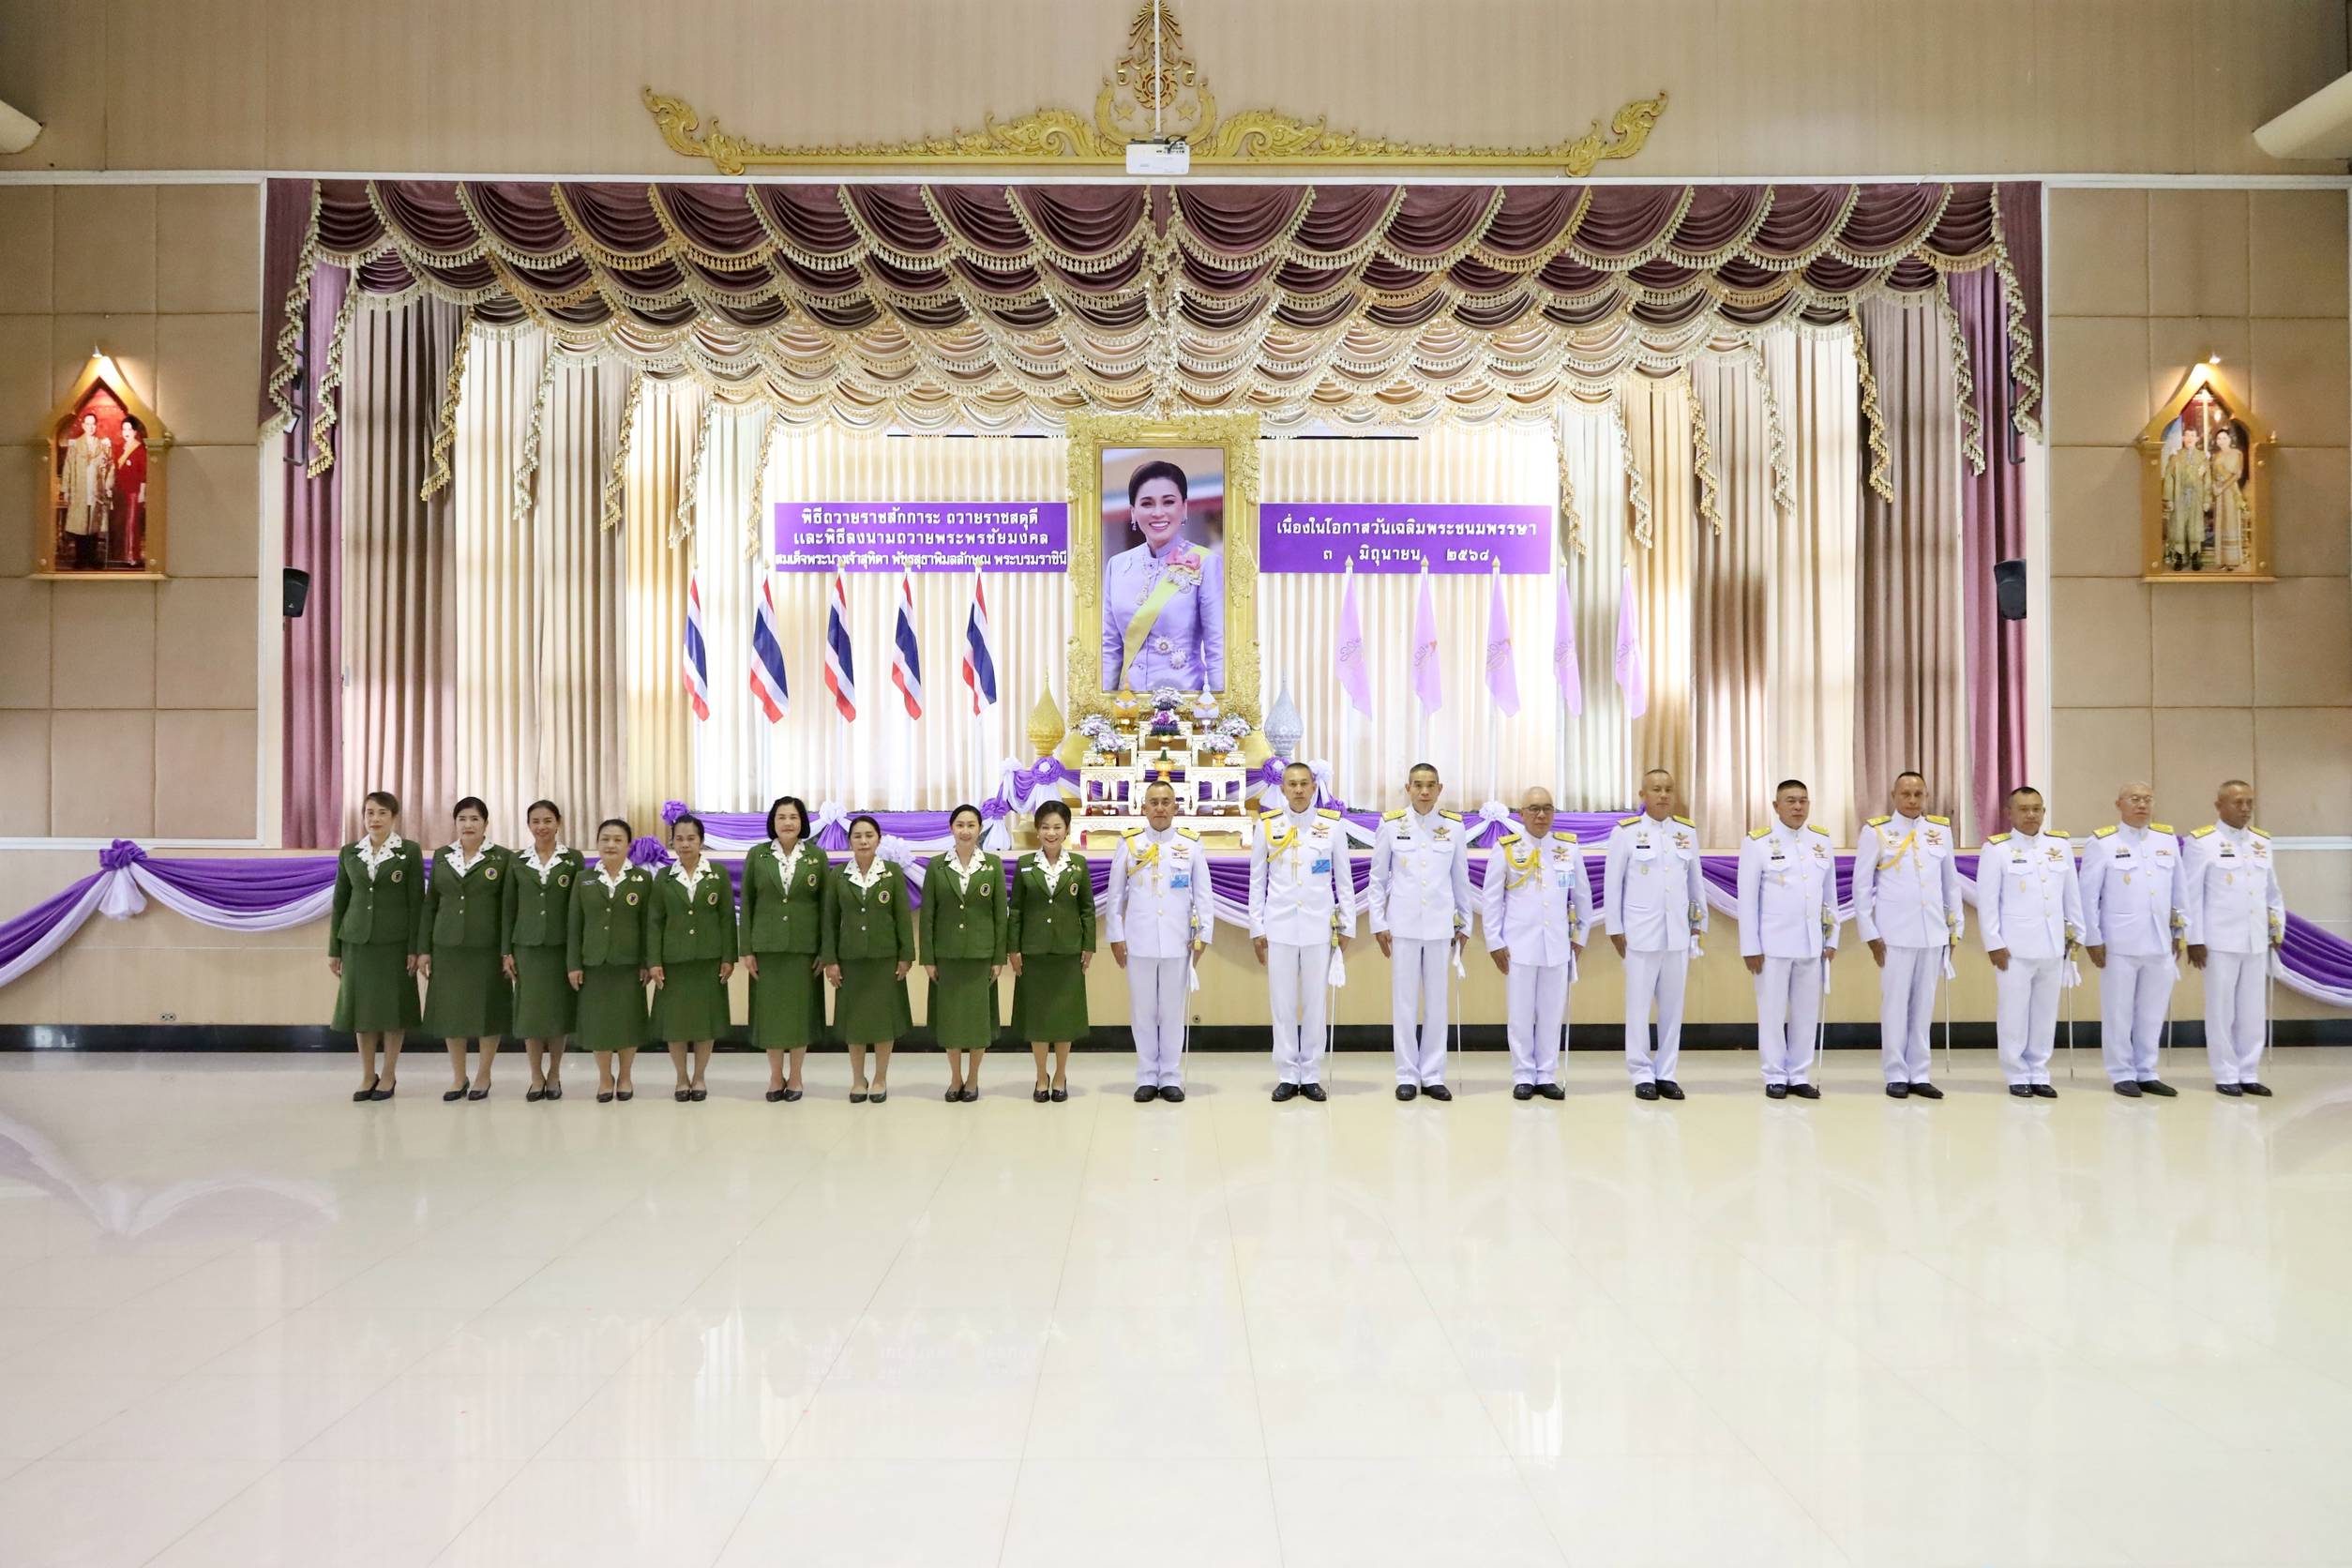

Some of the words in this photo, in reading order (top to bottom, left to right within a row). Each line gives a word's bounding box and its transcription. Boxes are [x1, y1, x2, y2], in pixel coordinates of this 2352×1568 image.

[802, 506, 941, 524] พิธีถวายราชสักการะ
[946, 507, 1038, 530] ถวายราชสดุดี
[1276, 514, 1537, 535] เนื่องในโอกาสวันเฉลิมพระชนมพรรษา
[794, 527, 1048, 544] และพิธีลงนามถวายพระพรชัยมงคล
[994, 550, 1067, 565] พระบรมราชินี
[1323, 550, 1333, 560] ๓
[1359, 544, 1421, 566] มิถุนายน
[1446, 548, 1489, 562] ๒๕๖๘
